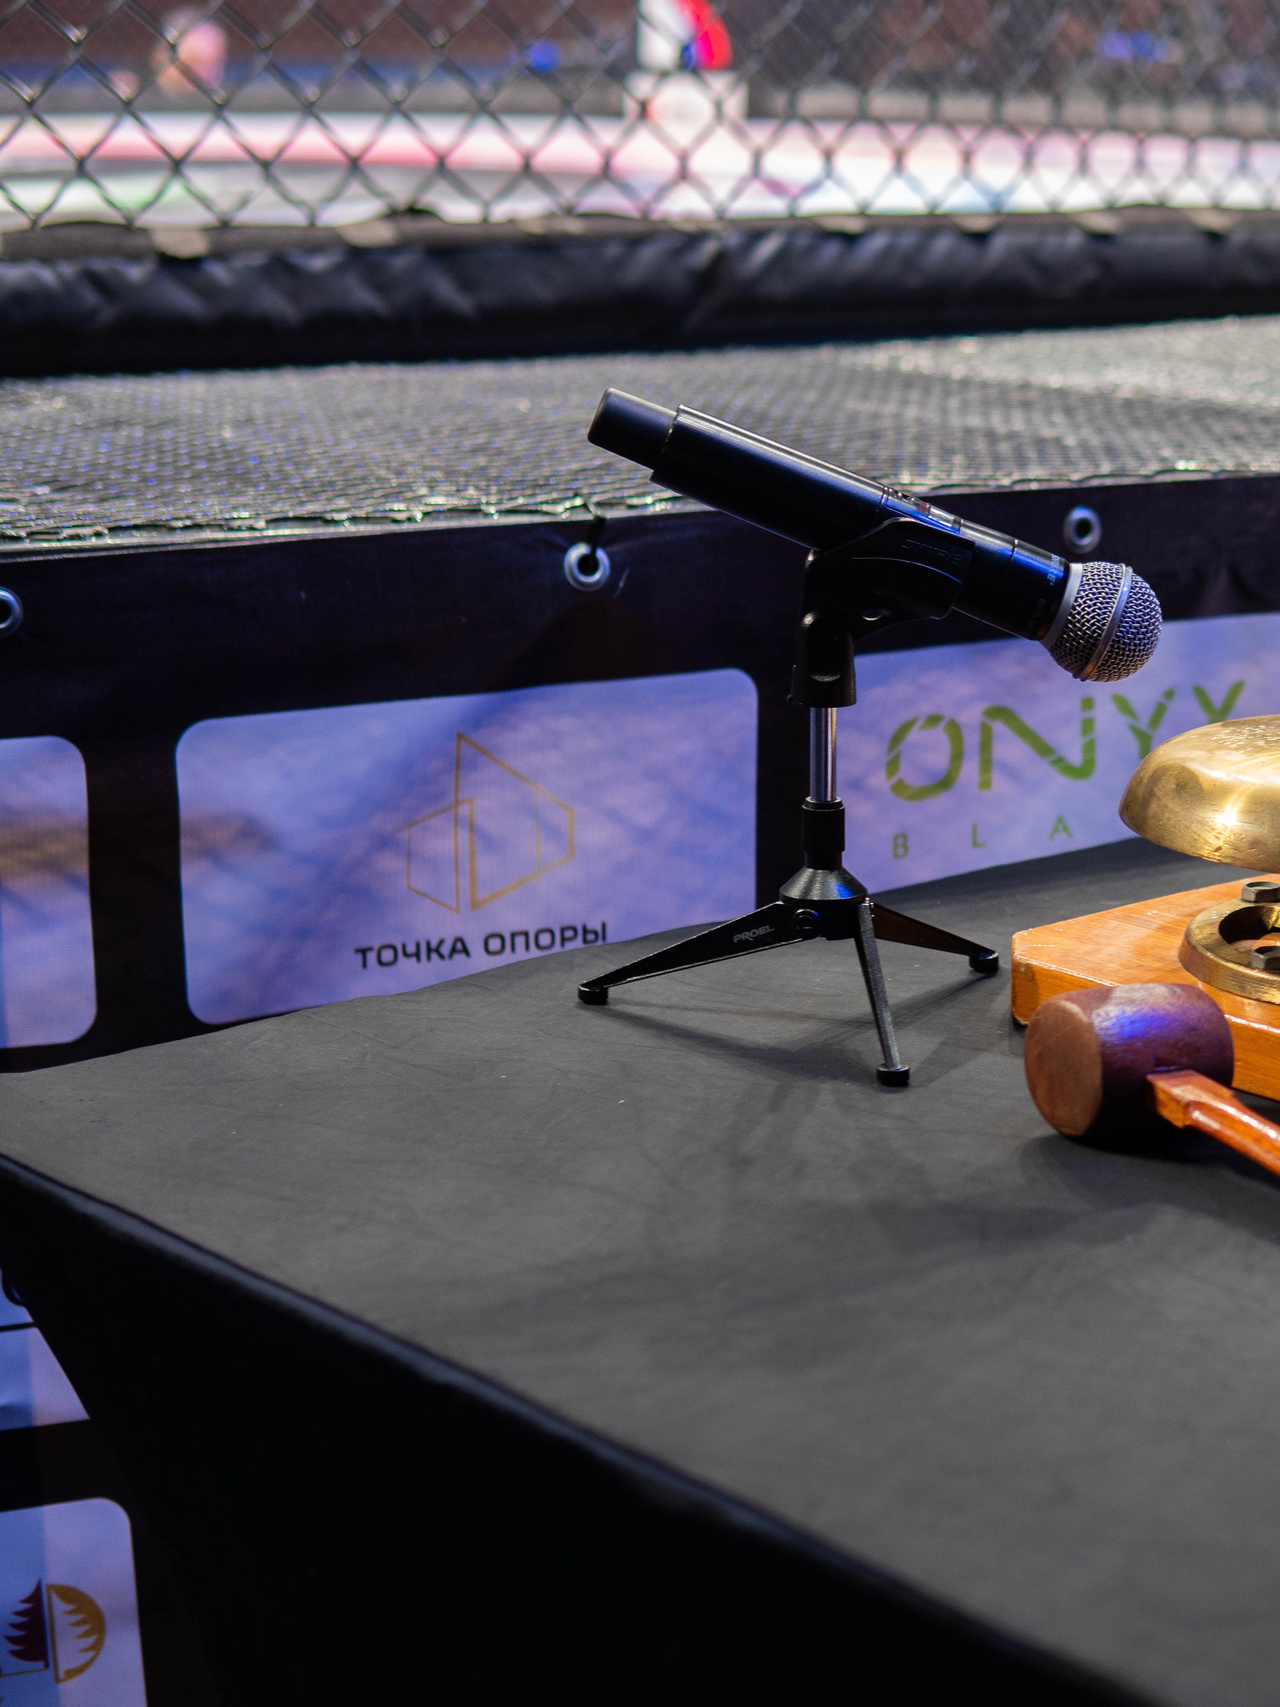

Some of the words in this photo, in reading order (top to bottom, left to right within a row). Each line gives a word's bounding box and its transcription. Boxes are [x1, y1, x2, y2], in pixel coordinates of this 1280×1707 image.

[354, 936, 471, 970] ТОЧКА
[483, 921, 607, 957] ОПОРЫ
[733, 925, 775, 943] PROEL
